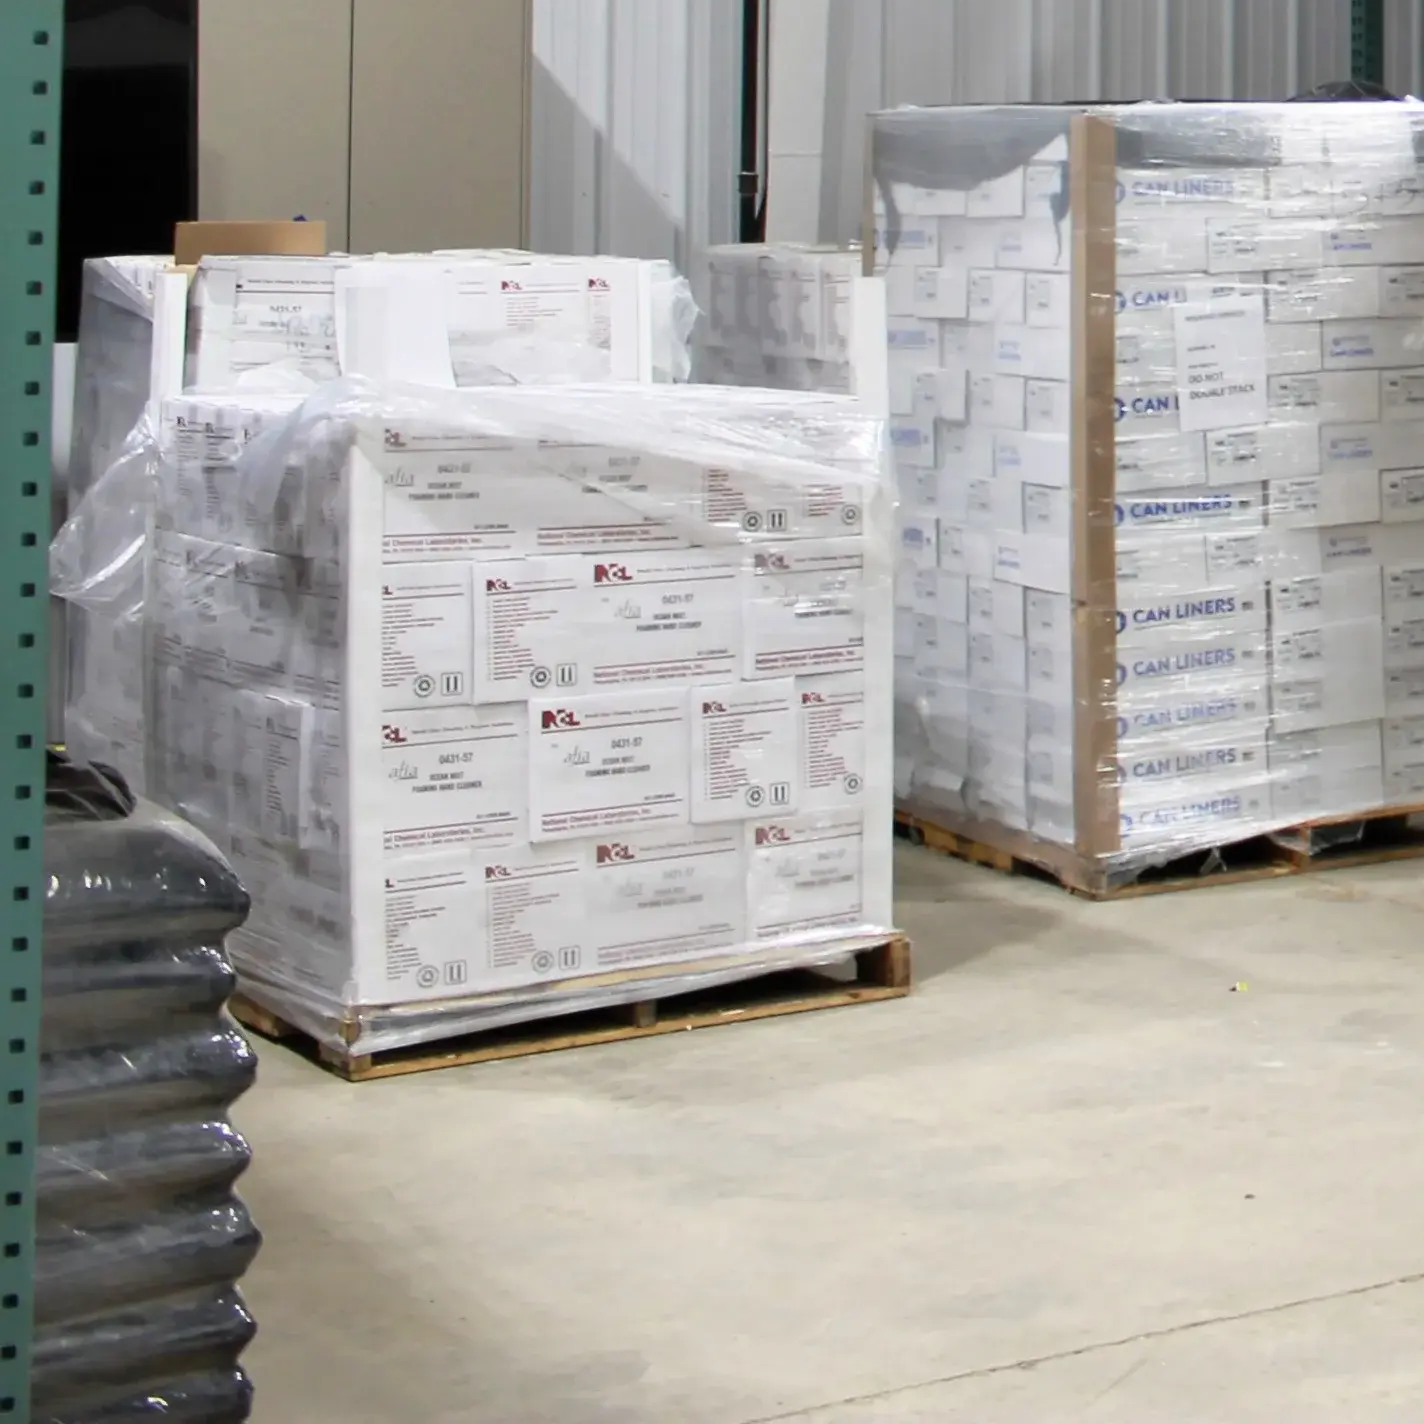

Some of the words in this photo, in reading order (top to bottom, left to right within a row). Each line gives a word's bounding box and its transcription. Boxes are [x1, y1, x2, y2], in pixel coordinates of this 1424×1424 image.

[1132, 290, 1171, 306] CAN
[1131, 397, 1171, 413] CAN
[1130, 502, 1168, 518] CAN
[1172, 494, 1233, 514] LINERS
[1133, 605, 1171, 623] CAN
[1176, 598, 1236, 619] LINERS
[1133, 659, 1171, 676] CAN
[1176, 648, 1236, 670] LINERS
[382, 725, 407, 743] CL
[1133, 761, 1171, 778] CAN
[1176, 748, 1236, 771] LINERS
